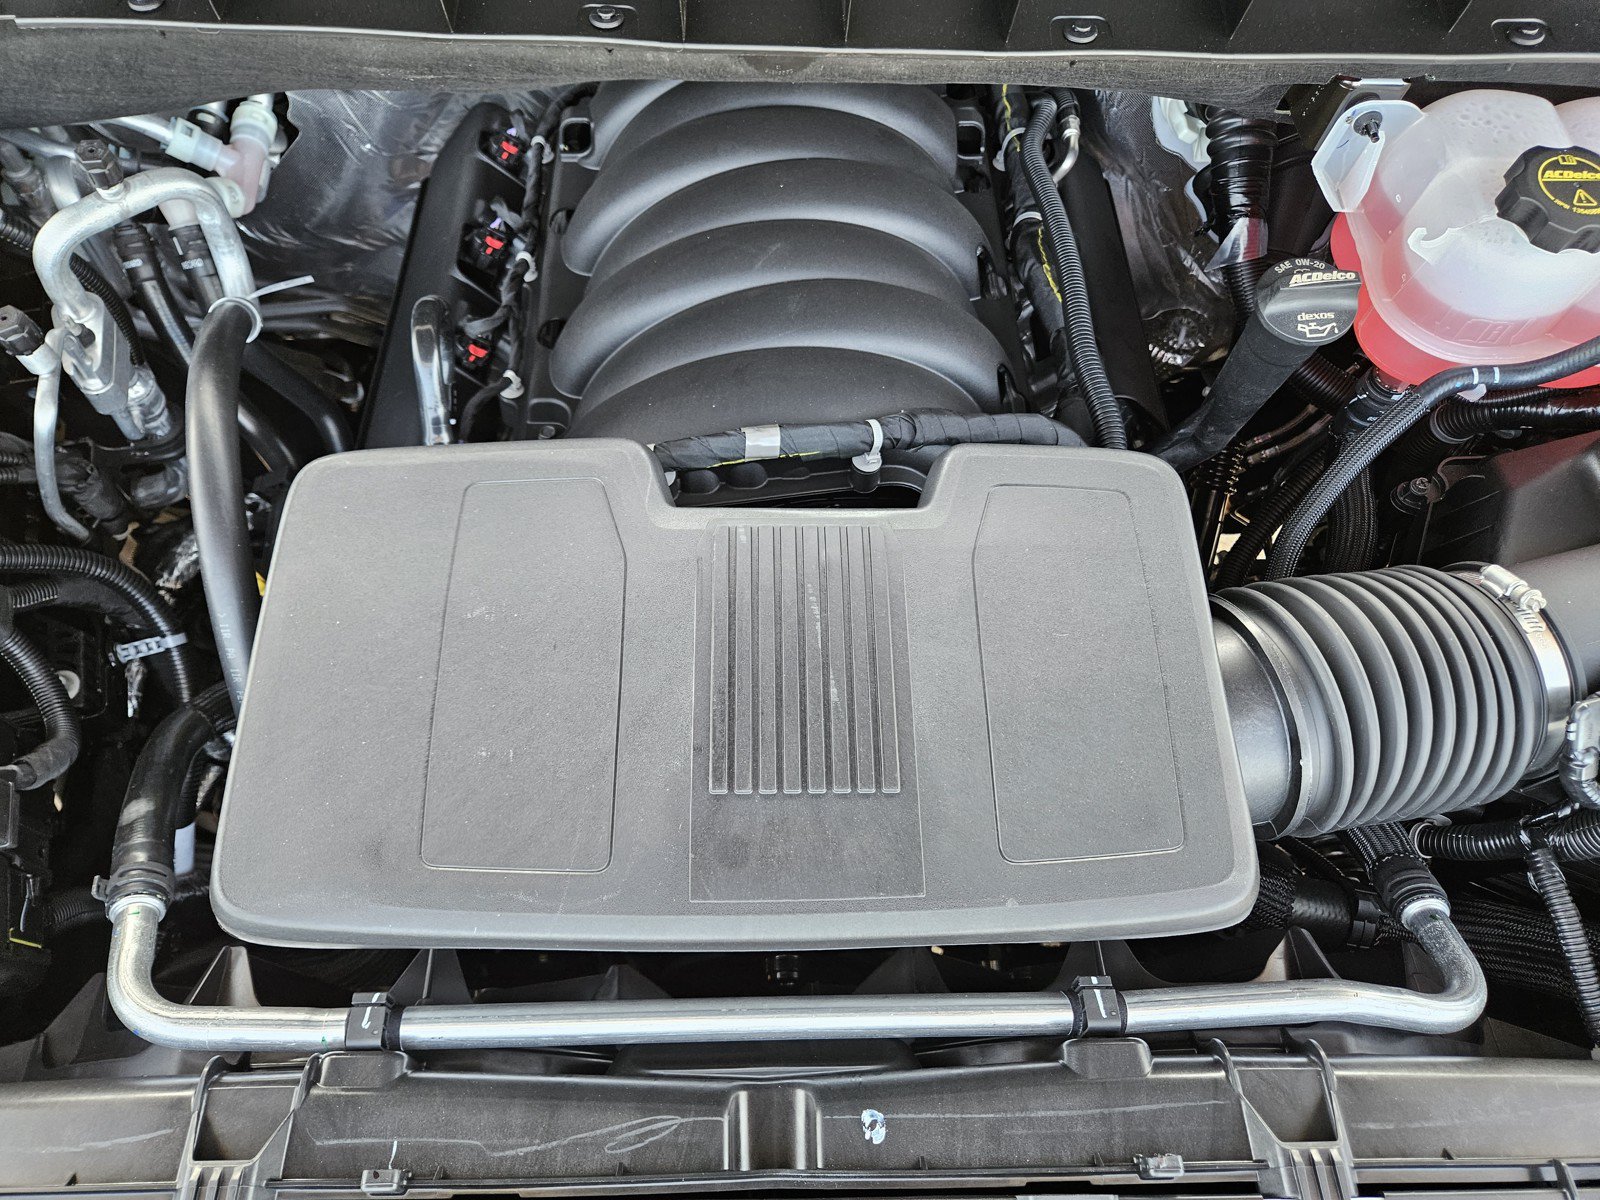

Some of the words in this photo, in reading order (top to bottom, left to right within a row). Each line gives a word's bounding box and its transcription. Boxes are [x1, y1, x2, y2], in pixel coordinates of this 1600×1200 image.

[1274, 260, 1293, 274] SAE
[1295, 258, 1326, 270] 0W-20
[1289, 270, 1356, 285] ACDelco
[1297, 311, 1335, 321] dexos
